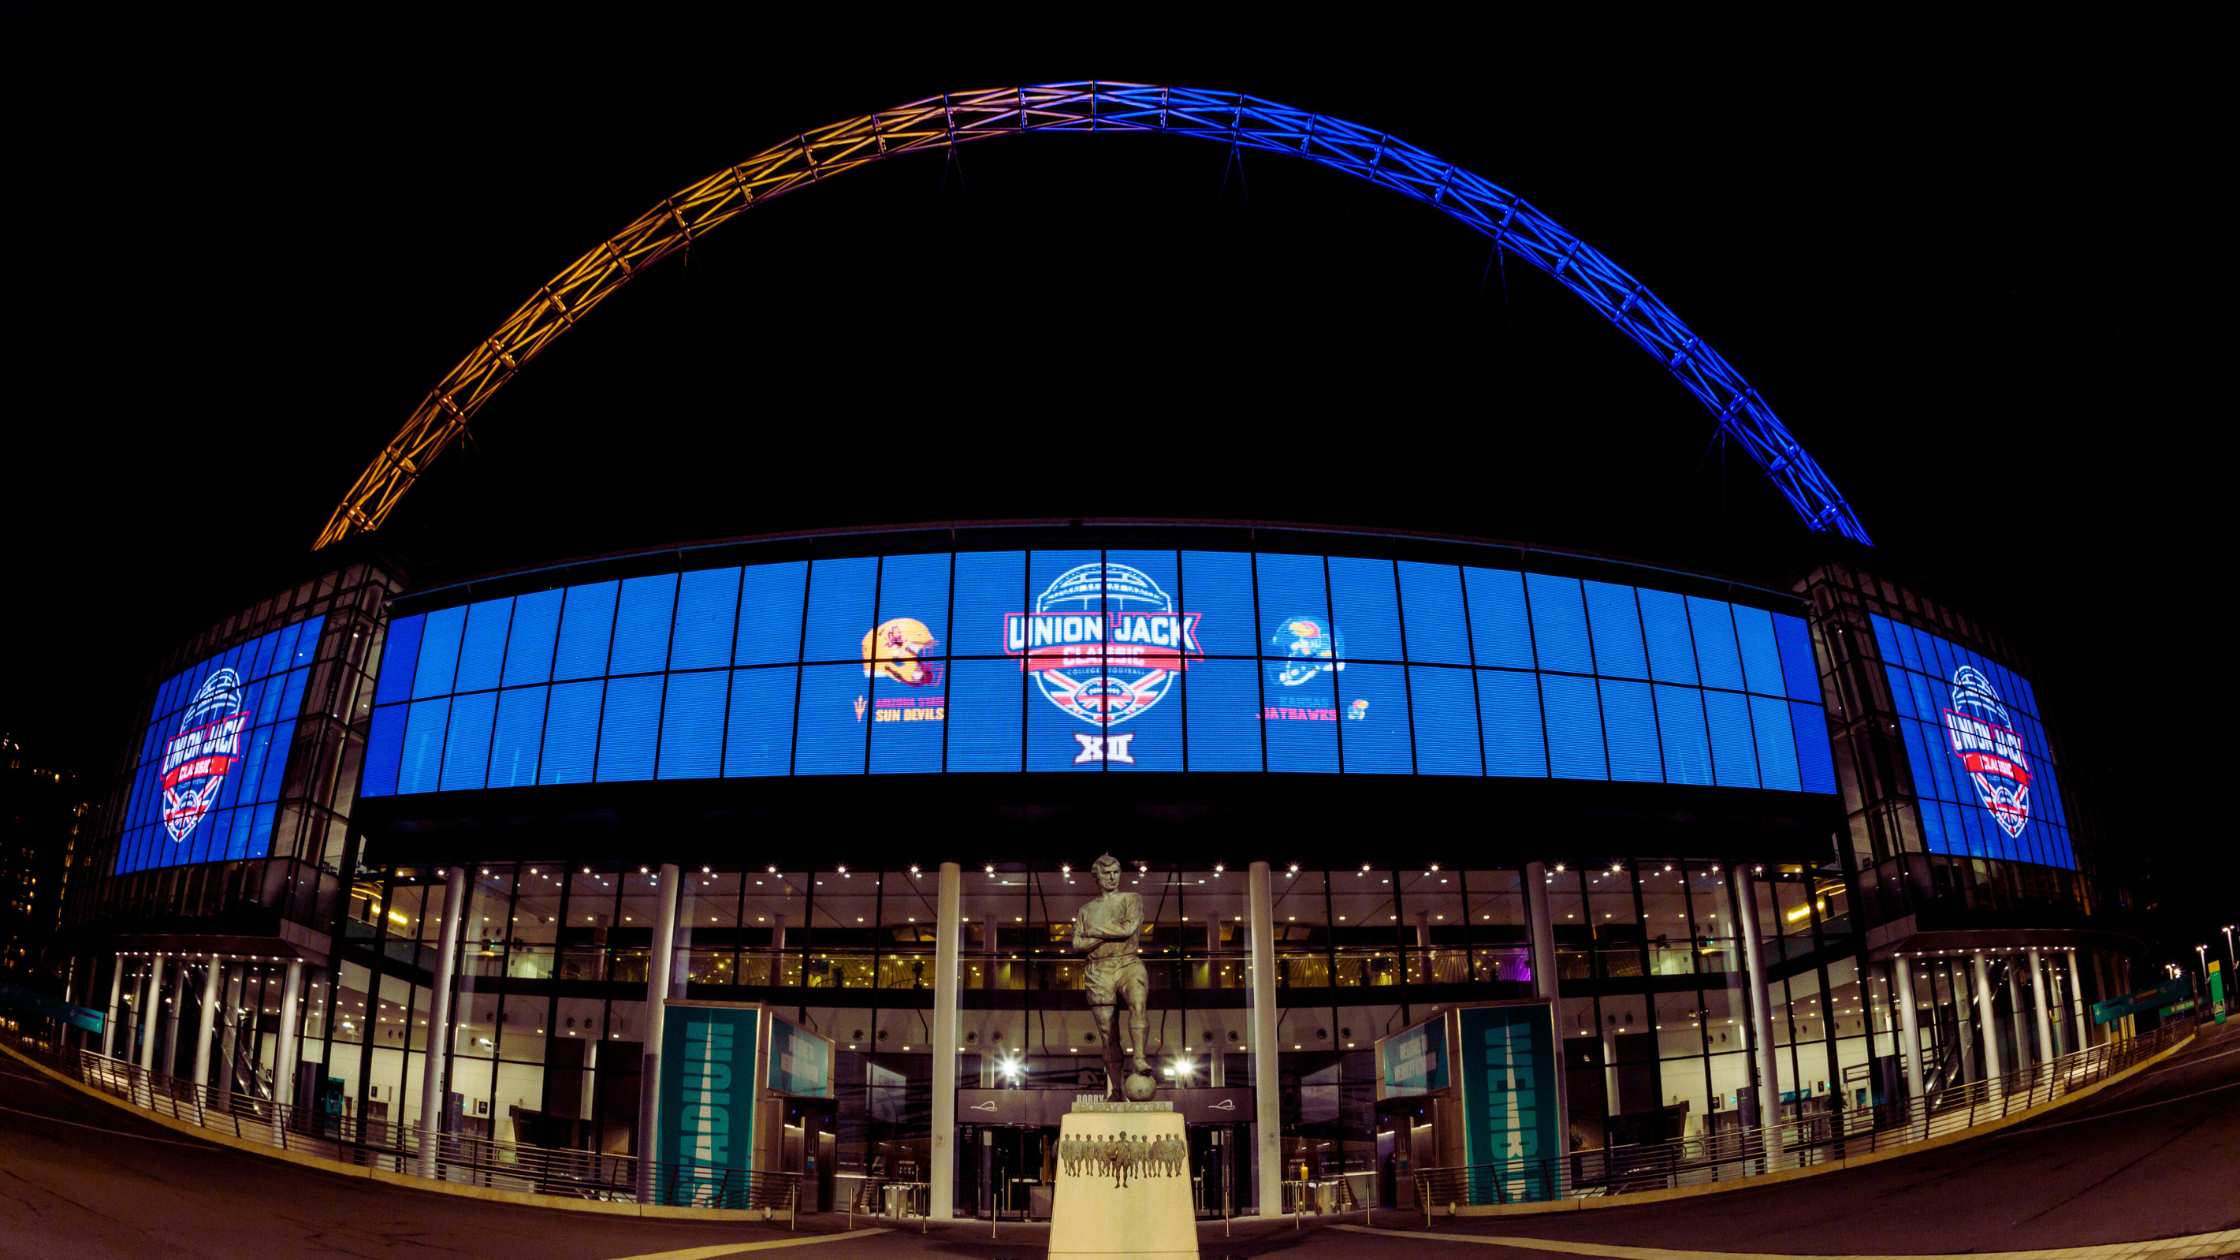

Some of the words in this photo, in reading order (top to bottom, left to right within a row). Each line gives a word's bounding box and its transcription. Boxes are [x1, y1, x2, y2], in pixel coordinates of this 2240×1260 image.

[1009, 616, 1104, 650] UNION
[1115, 616, 1195, 650] JACK
[1063, 646, 1145, 666] CLASSIC
[875, 709, 901, 722] SUN
[903, 707, 945, 721] DEVILS
[1255, 707, 1341, 721] JAYHAWKS
[162, 730, 205, 775] UNION
[202, 716, 245, 755] JACK
[1947, 713, 1995, 752] UNION
[1994, 729, 2029, 772] JACK
[1485, 1022, 1540, 1202] WEMBLE
